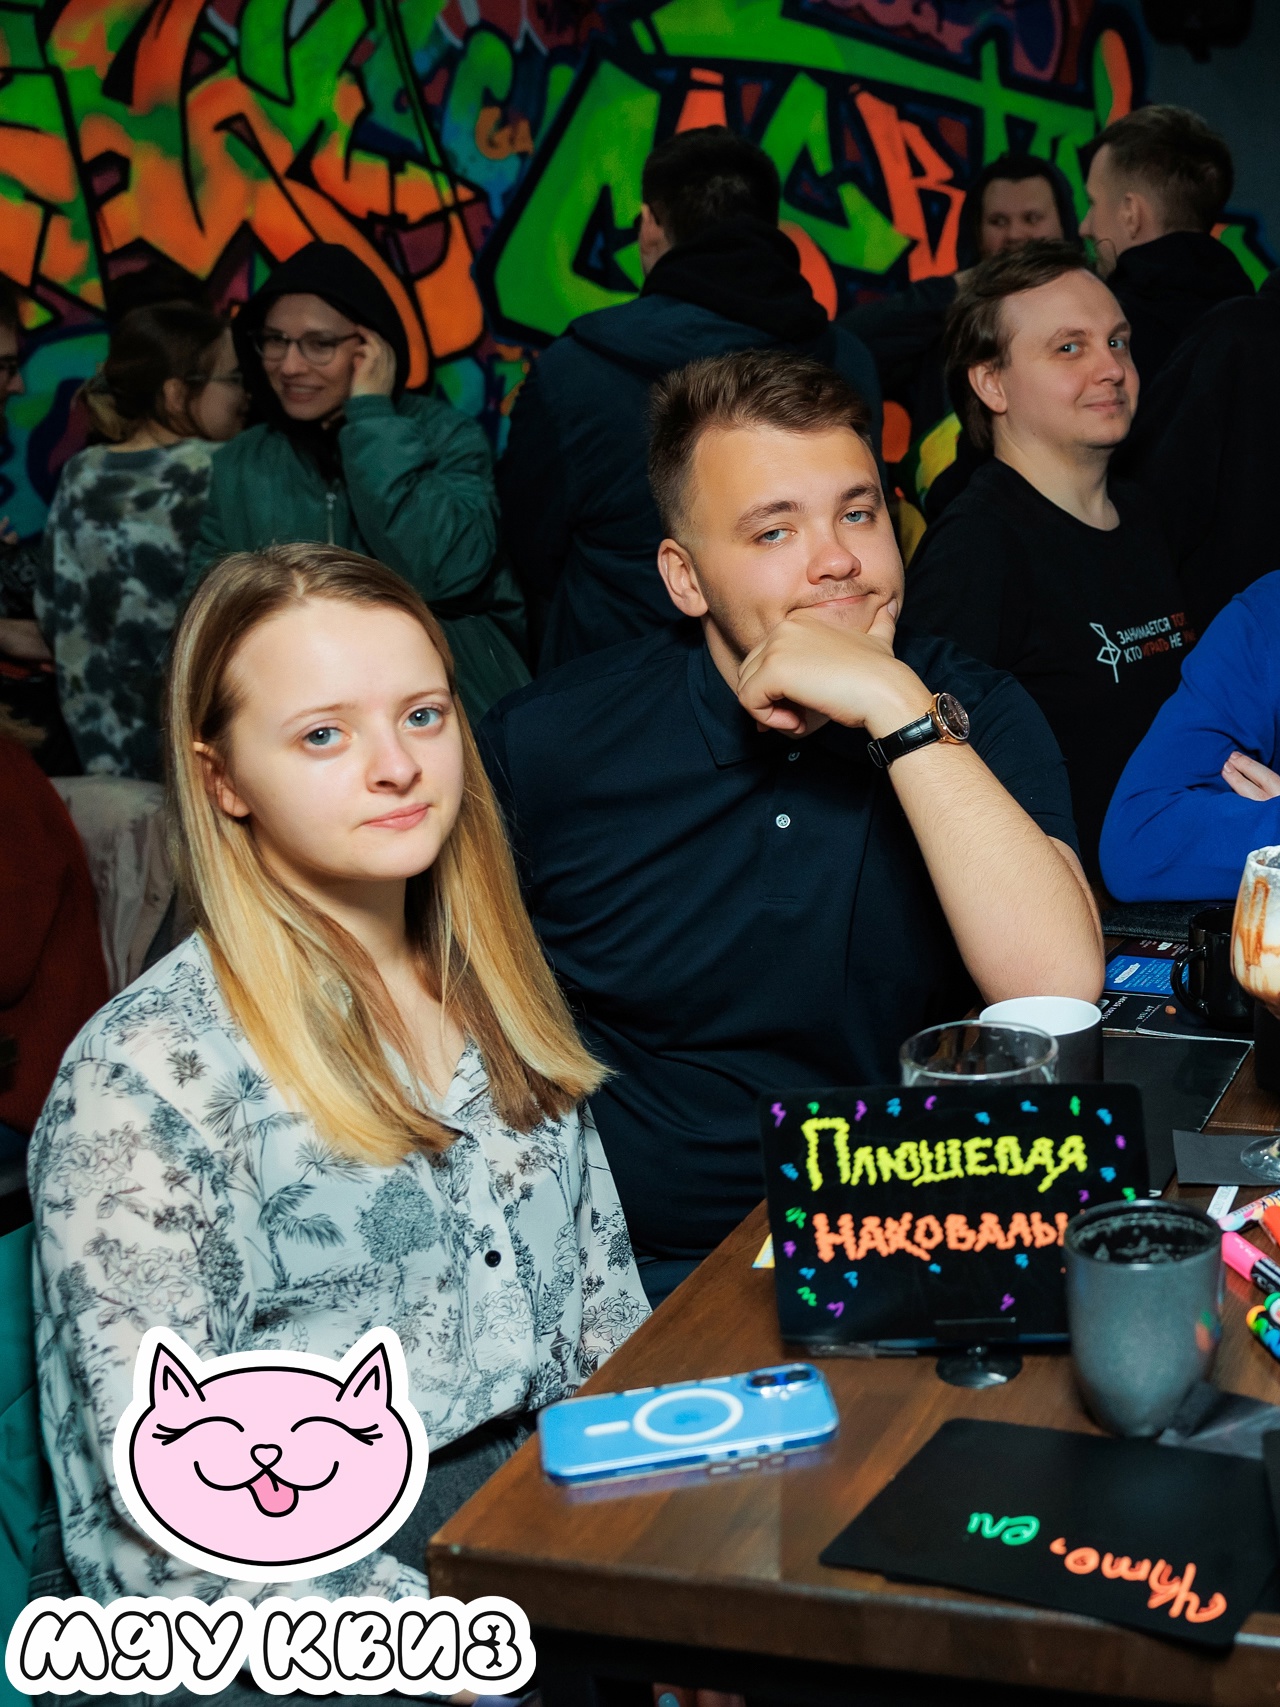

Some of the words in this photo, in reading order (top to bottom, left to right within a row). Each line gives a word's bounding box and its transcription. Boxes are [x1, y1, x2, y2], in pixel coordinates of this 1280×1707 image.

[1116, 616, 1172, 646] ЗАНИМАЕТСЯ
[1123, 645, 1143, 664] КТО
[1169, 632, 1183, 649] НЕ
